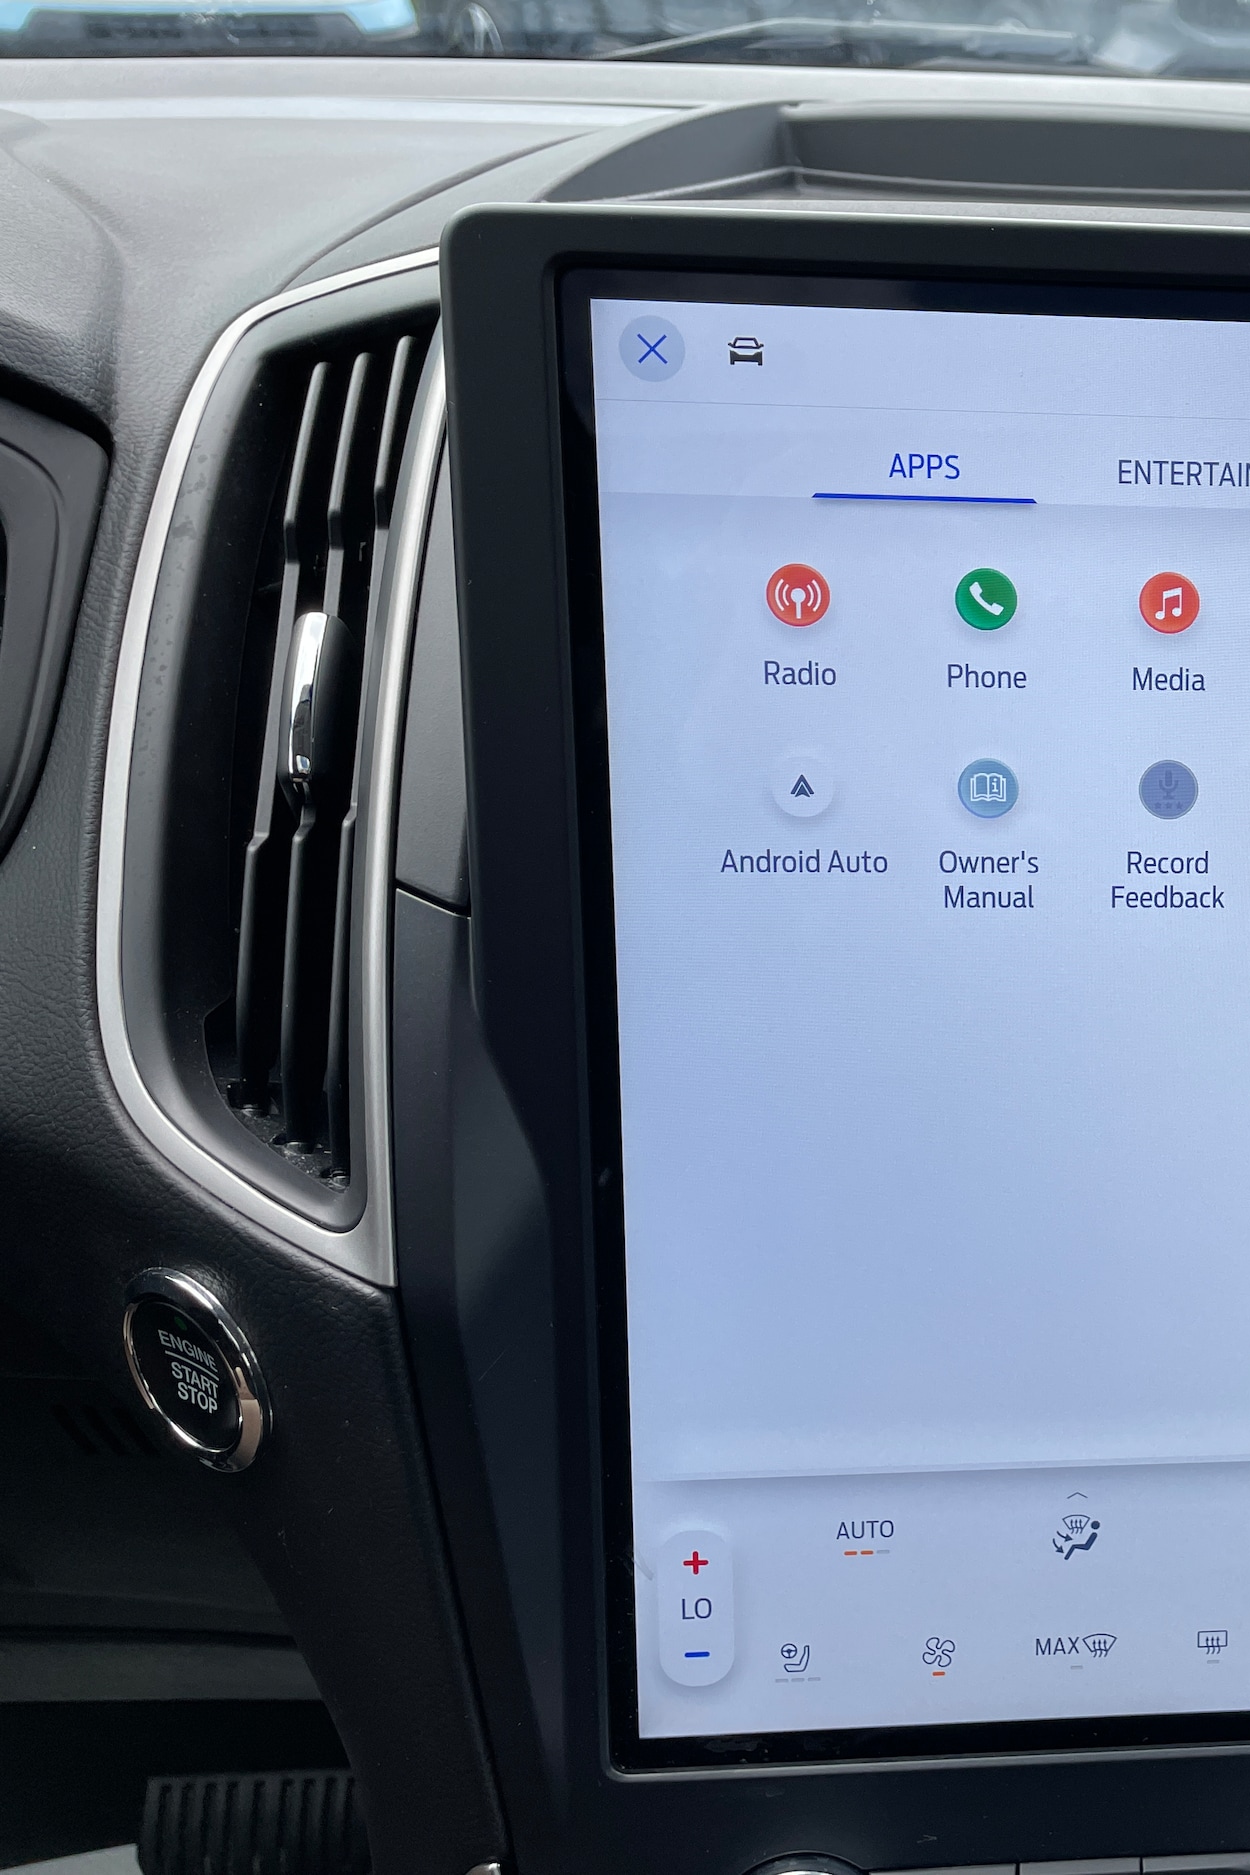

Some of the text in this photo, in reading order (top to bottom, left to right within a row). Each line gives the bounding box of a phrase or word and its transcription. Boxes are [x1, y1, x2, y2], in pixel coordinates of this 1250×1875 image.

[888, 452, 960, 480] APPS
[764, 660, 837, 686] Radio
[947, 663, 1027, 689] Phone
[1132, 666, 1206, 692] Media
[720, 848, 888, 874] Android Auto
[939, 850, 1039, 874] Owner's
[1127, 850, 1209, 874] Record
[944, 884, 1035, 909] Manual
[1111, 884, 1225, 909] Feedback
[158, 1330, 218, 1373] ENGINE
[171, 1362, 218, 1399] START
[177, 1382, 218, 1413] STOP
[836, 1519, 894, 1540] AUTO
[681, 1597, 712, 1620] LO
[1035, 1636, 1080, 1656] MAX
